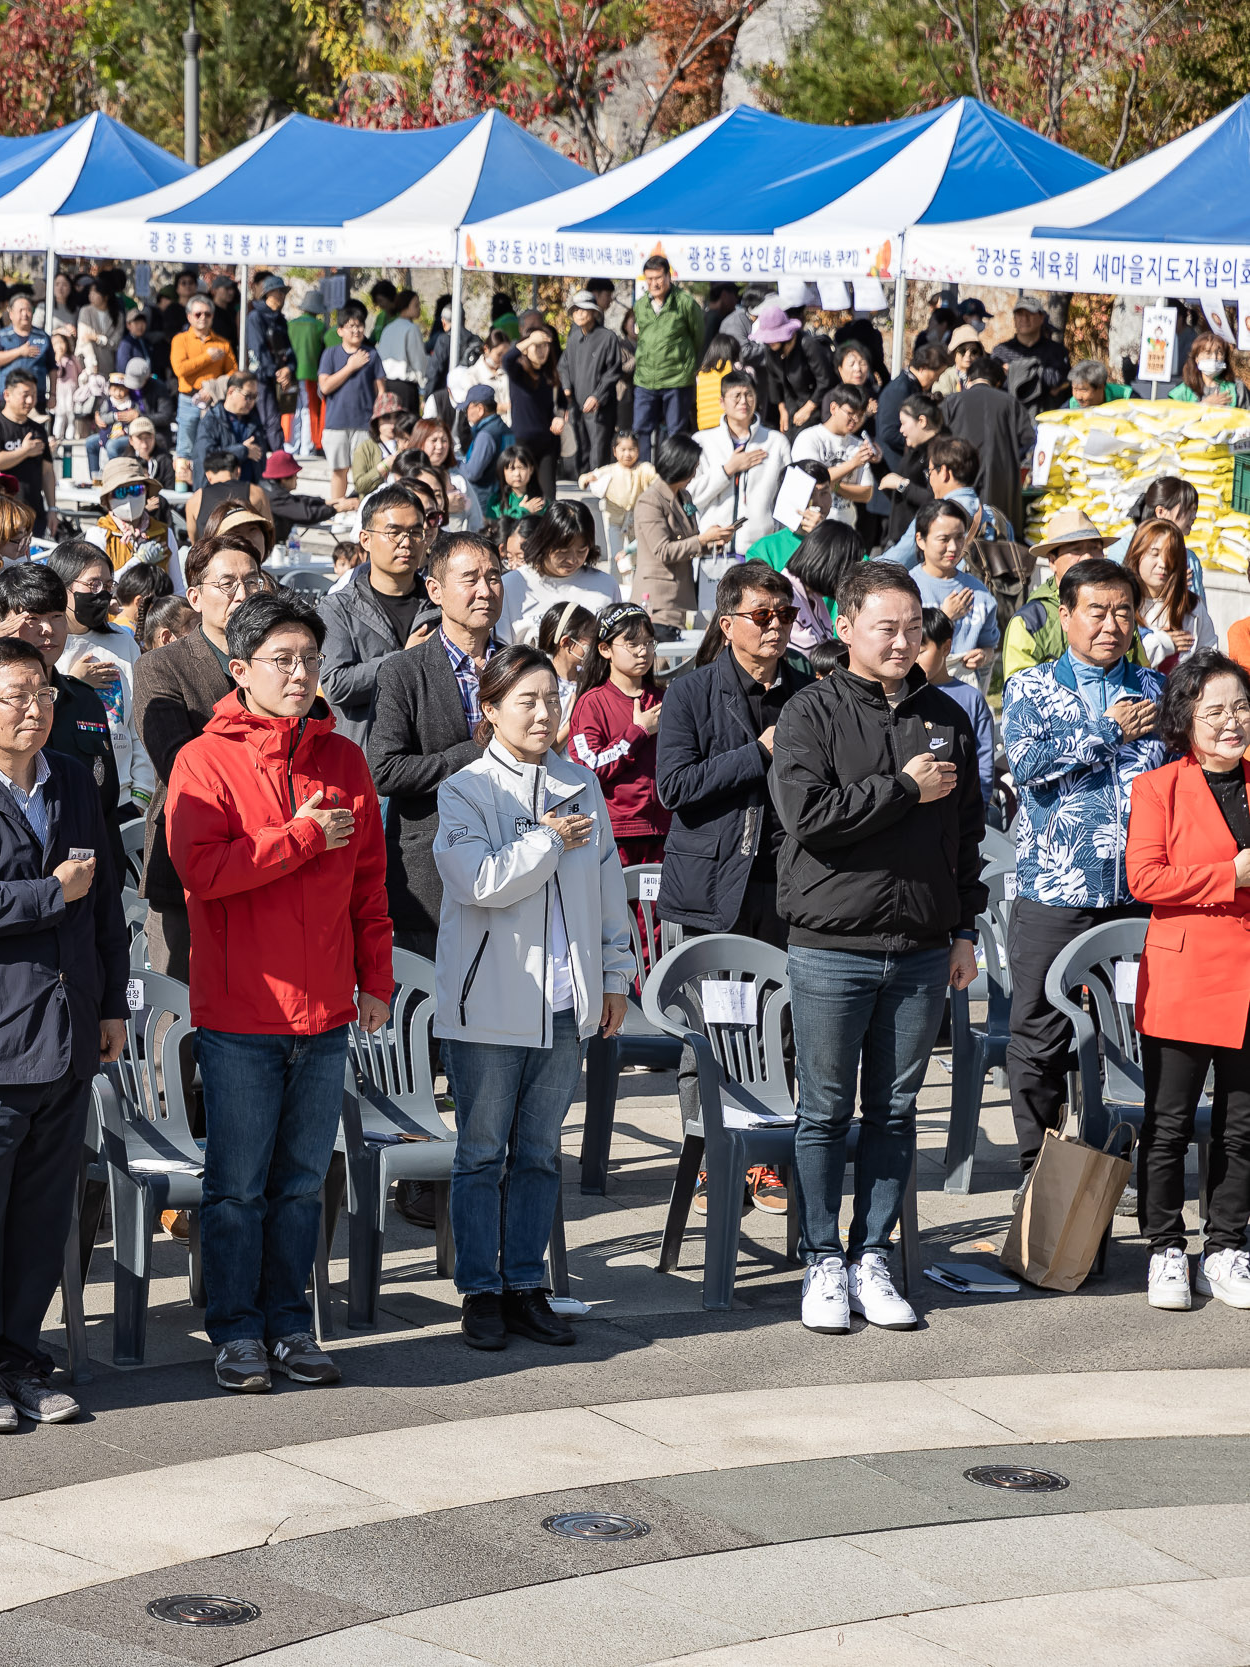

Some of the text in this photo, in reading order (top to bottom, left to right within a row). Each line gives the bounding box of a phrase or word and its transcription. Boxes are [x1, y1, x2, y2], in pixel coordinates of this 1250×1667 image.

[149, 231, 193, 255] 광장동
[205, 232, 305, 257] 자원봉사캠프
[486, 240, 522, 264] 광장동
[527, 241, 565, 266] 상인회
[687, 245, 731, 272] 광장동
[740, 245, 786, 273] 상인회
[975, 248, 1022, 278] 광장동
[1029, 250, 1079, 281] 체육회
[273, 1341, 291, 1362] N
